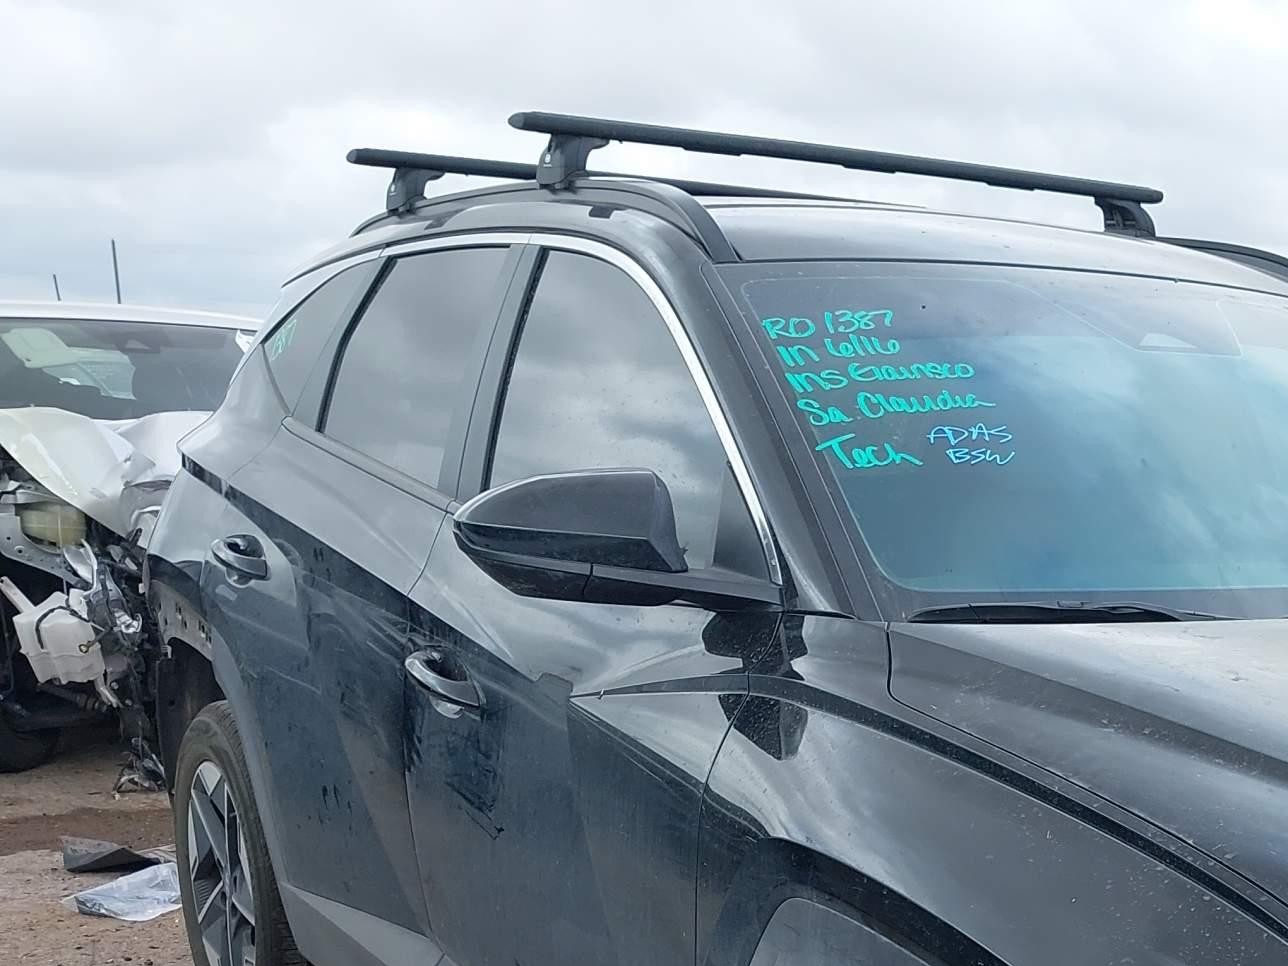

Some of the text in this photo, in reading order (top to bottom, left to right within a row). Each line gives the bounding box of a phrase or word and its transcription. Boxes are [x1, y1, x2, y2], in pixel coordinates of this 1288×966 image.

[762, 310, 894, 339] RO 1387
[926, 423, 1013, 446] ADAS
[815, 433, 924, 469] Tech
